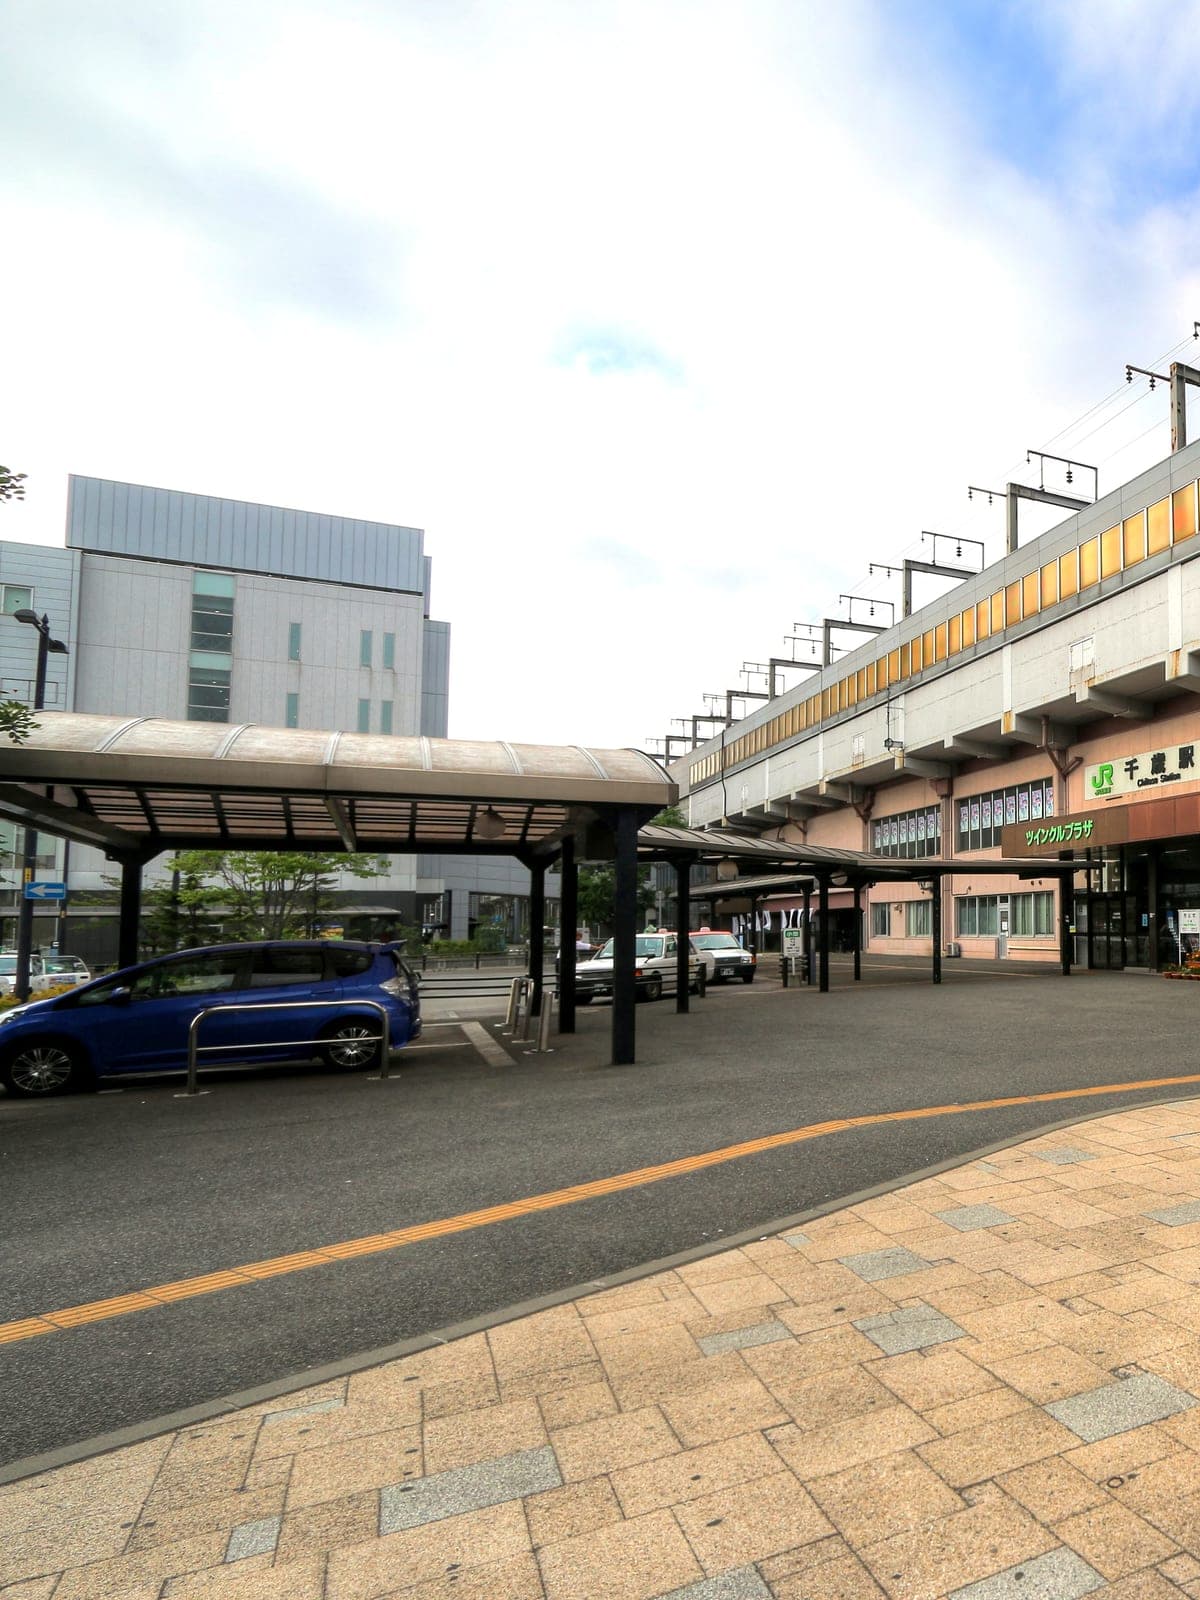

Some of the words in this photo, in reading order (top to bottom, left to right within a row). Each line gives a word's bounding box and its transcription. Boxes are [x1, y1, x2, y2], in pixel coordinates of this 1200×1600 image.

[1092, 763, 1114, 788] JR
[1124, 745, 1195, 780] 千歳駅
[1160, 772, 1181, 783] Station
[1026, 819, 1093, 846] ツインクルプラザ
